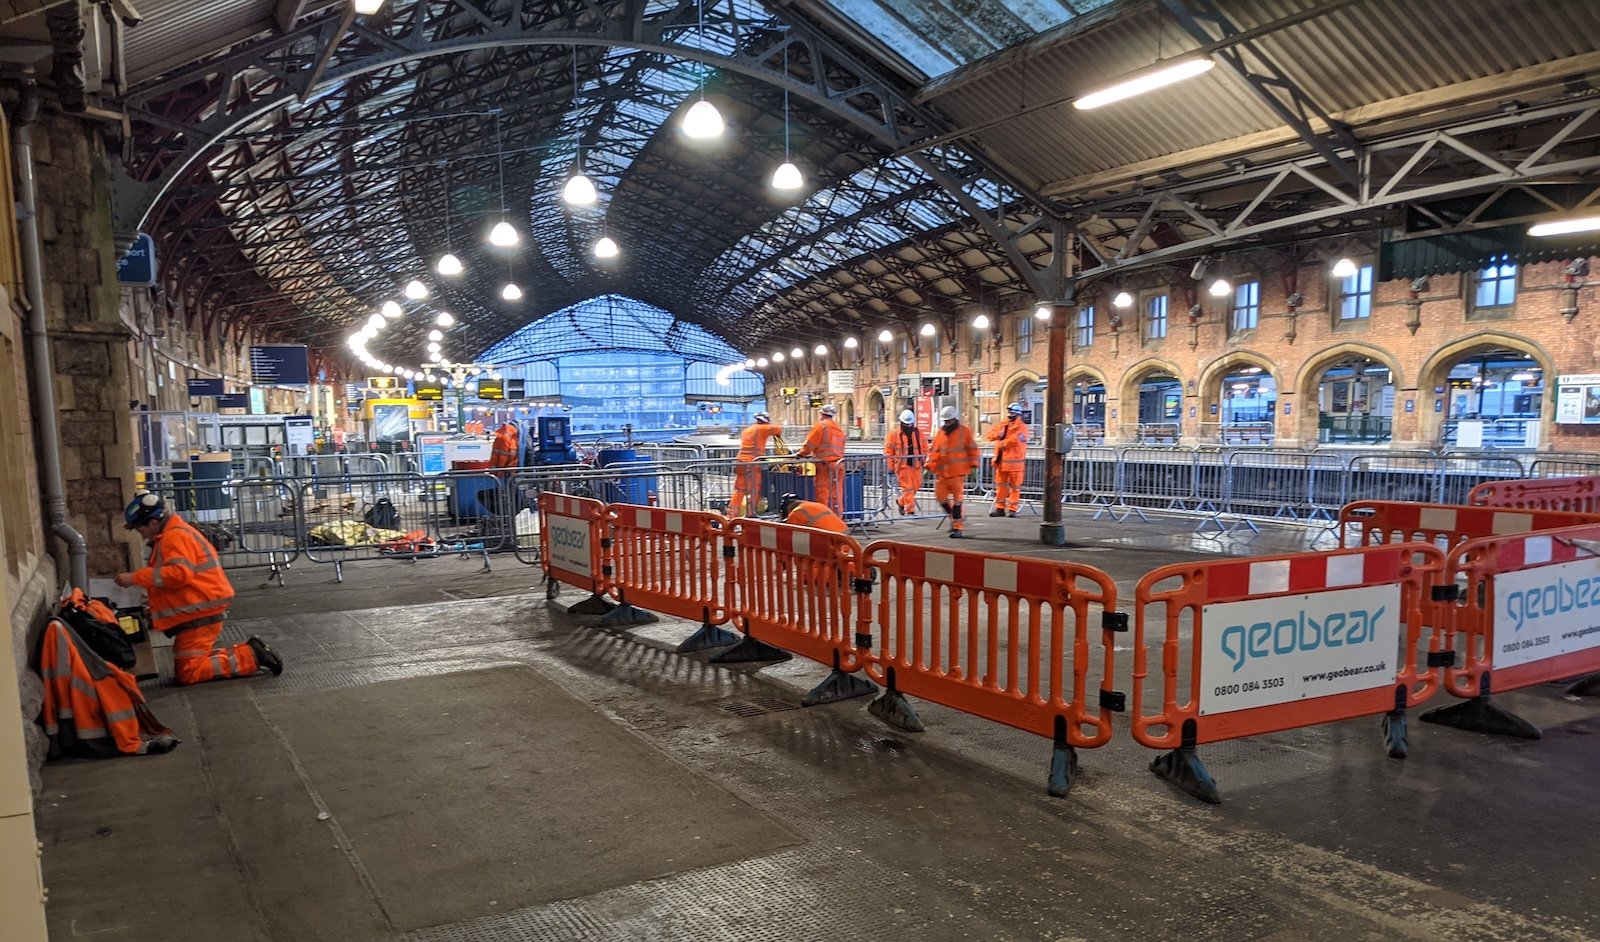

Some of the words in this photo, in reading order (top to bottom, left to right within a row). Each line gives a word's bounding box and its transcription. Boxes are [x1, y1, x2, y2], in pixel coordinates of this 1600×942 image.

[551, 525, 587, 550] geobear
[1506, 576, 1600, 632] geobea
[1221, 605, 1386, 673] geobear
[1502, 642, 1520, 653] 0800
[1521, 638, 1534, 649] 084
[1534, 635, 1551, 646] 3503
[1214, 684, 1240, 697] 0800
[1242, 680, 1260, 693] 084
[1262, 677, 1285, 690] 3503
[1302, 661, 1387, 683] www.geobear.co.uk
